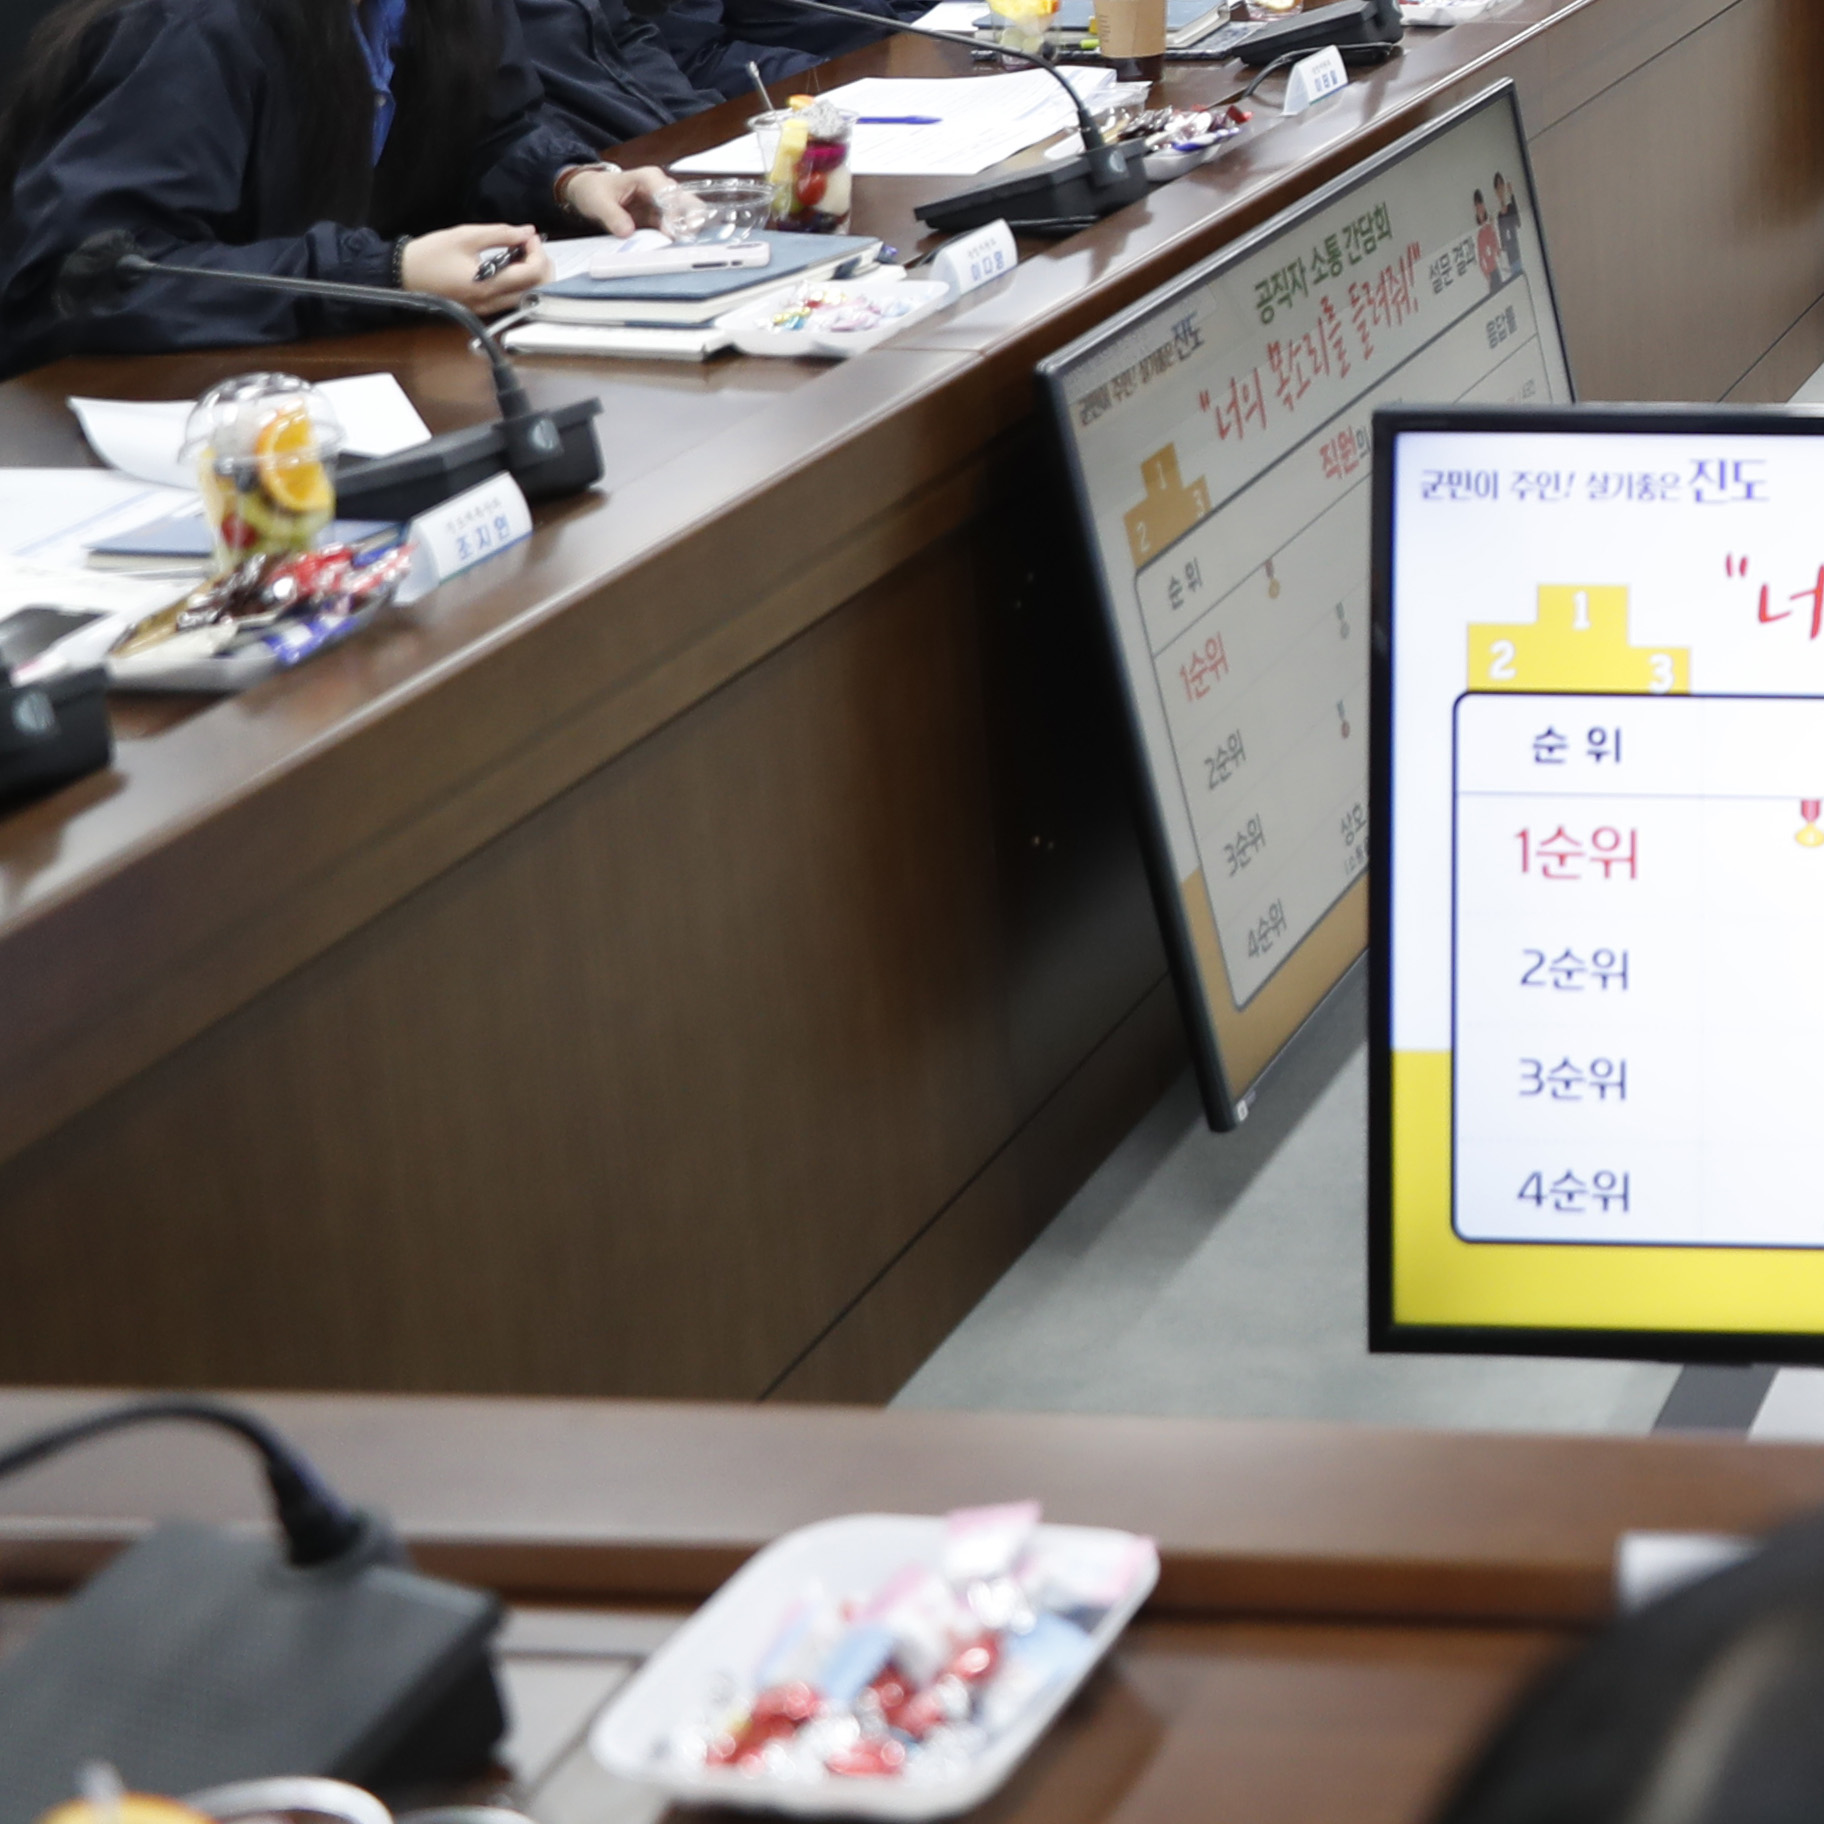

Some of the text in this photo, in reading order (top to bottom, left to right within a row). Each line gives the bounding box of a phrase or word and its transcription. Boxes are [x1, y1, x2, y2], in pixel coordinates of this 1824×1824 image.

[1255, 201, 1393, 325] 공직자 소통 간담회
[1421, 458, 1770, 503] 군민이 주인! 살기좋은 진도
[1573, 590, 1592, 631] 1
[1489, 640, 1517, 681] 2
[1648, 652, 1675, 694] 3
[1514, 824, 1637, 880] 1순위
[1520, 947, 1629, 991] 2순위
[1518, 1056, 1627, 1101] 3순위
[1517, 1168, 1630, 1213] 4순위
